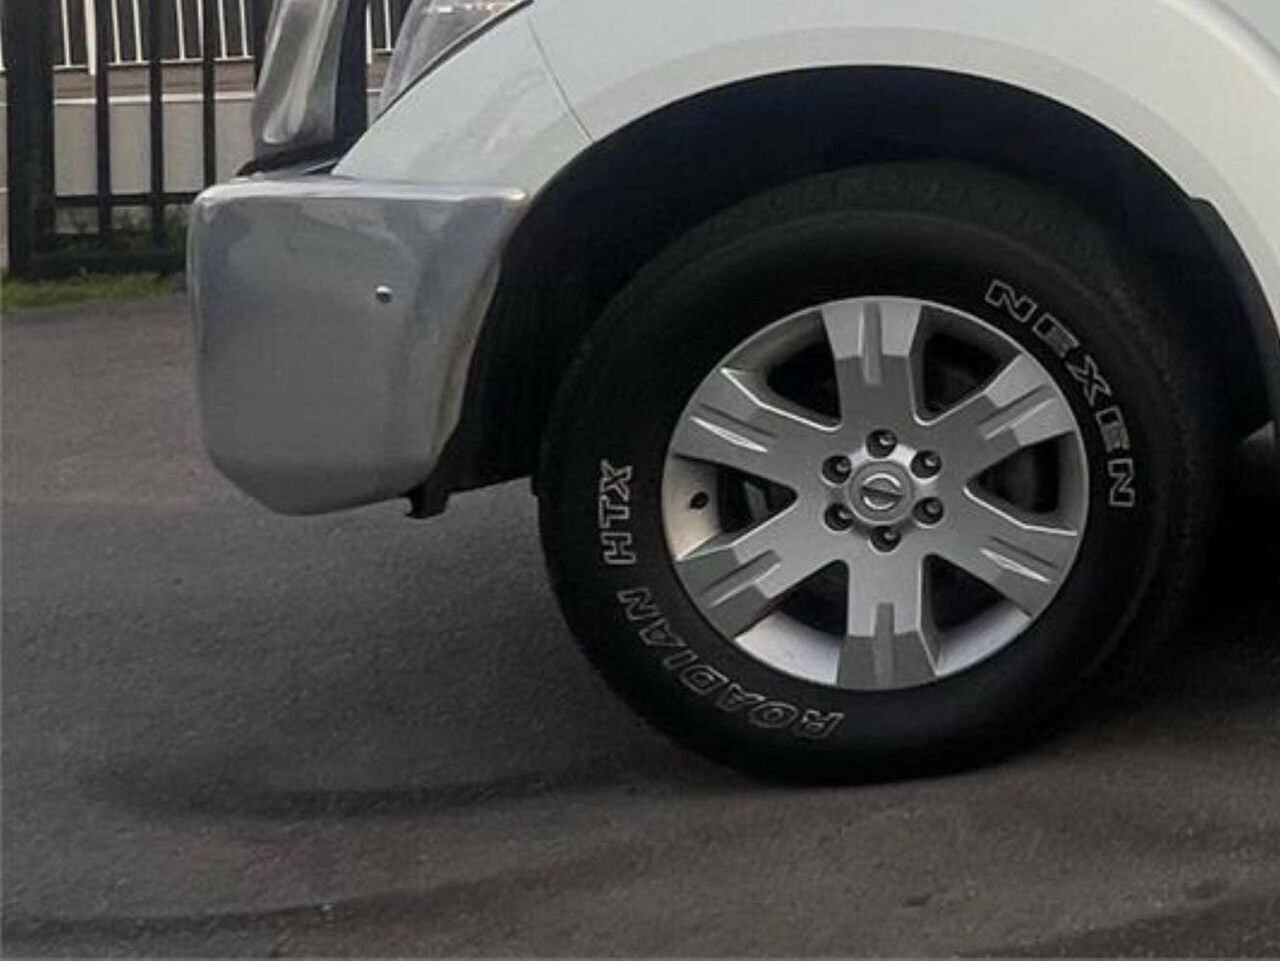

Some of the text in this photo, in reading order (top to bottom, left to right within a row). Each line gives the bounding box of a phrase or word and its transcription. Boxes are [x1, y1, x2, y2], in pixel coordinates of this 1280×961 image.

[985, 279, 1136, 507] NEXEN
[600, 459, 844, 738] ROADIAN HTX
